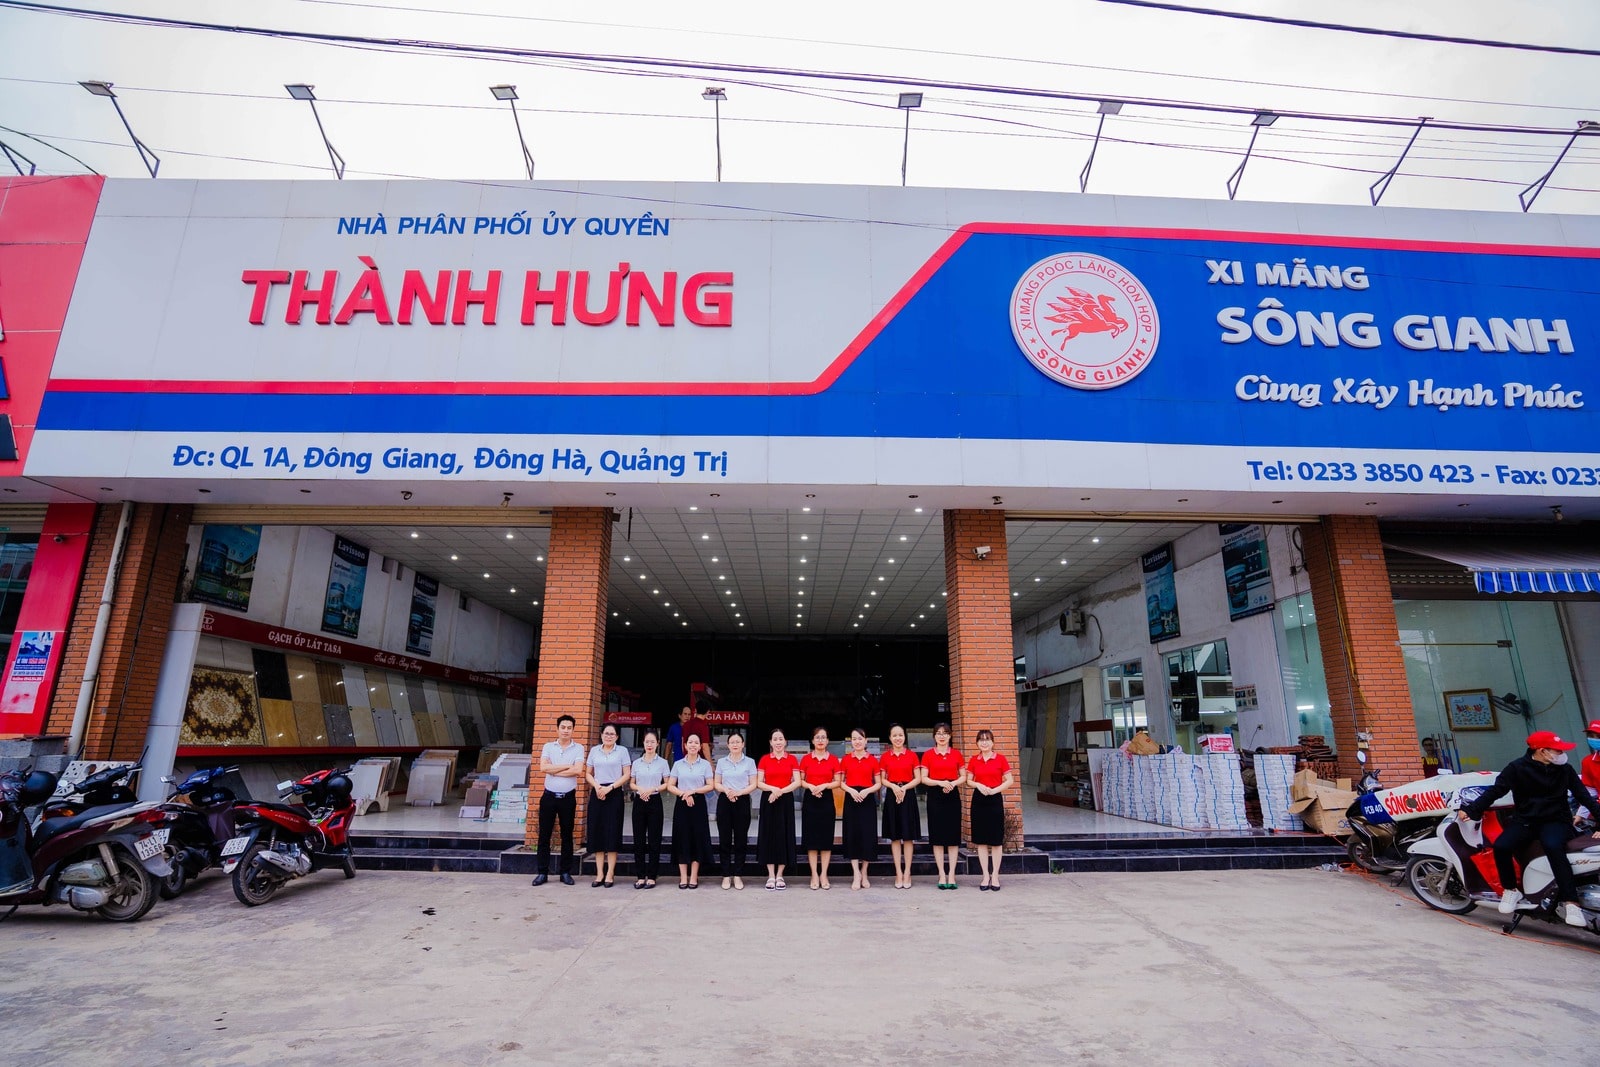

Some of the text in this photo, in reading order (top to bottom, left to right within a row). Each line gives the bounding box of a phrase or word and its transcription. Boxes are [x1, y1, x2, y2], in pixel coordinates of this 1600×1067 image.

[337, 210, 671, 237] NHÀ PHÂN PHỐI ỦY QUYỀN
[1206, 257, 1371, 290] XI MĂNG
[242, 256, 733, 327] THÀNH HƯNG
[1018, 318, 1032, 331] XI
[1217, 298, 1576, 355] SÔNG GIANH
[1036, 347, 1147, 382] SÔNG GIANH
[1234, 374, 1585, 412] Cùng Xây Hạnh Phúc
[172, 444, 729, 478] Đc: QL 1A, Đông Giang, Đông Hà, Quảng Trị
[1245, 459, 1295, 482] Tel:
[1296, 461, 1359, 483] 0233
[1362, 462, 1426, 485] 3850
[1427, 463, 1477, 486] 423
[1494, 464, 1549, 486] Fax:
[337, 539, 366, 560] Lavisson
[1143, 550, 1168, 567] Lavisson
[267, 630, 293, 645] GẠCH
[323, 643, 342, 655] TASA
[705, 713, 722, 721] GIA
[1364, 804, 1384, 815] PCB 40
